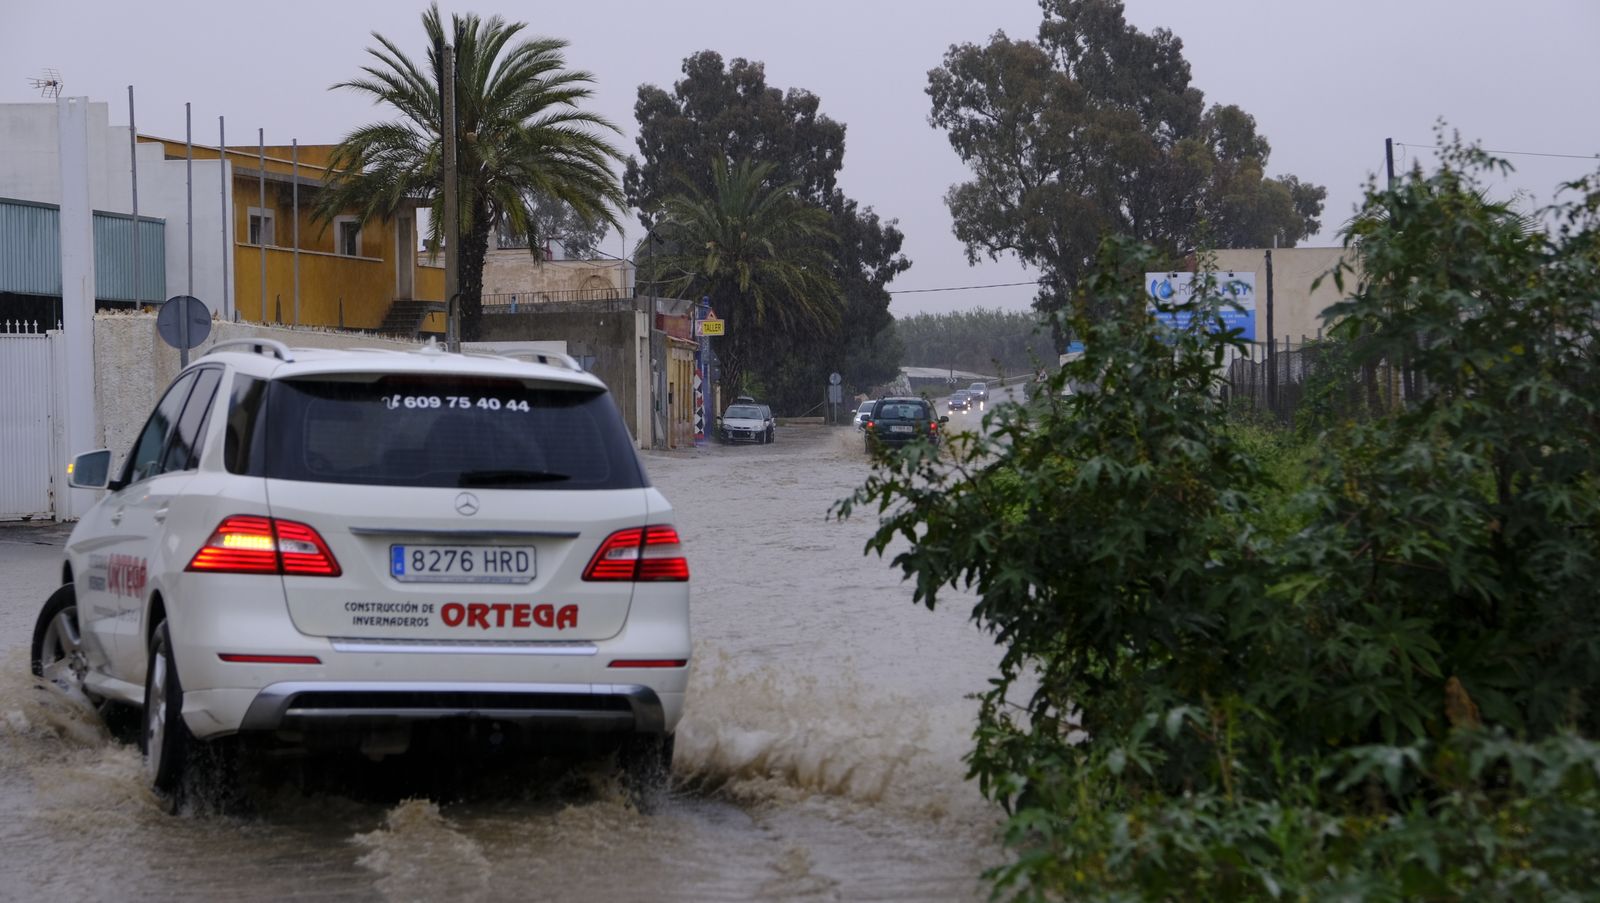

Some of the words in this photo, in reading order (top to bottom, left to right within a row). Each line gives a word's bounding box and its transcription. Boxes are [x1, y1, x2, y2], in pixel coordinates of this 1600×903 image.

[704, 323, 721, 332] TALLER
[404, 396, 441, 409] 609
[446, 396, 472, 409] 75
[477, 397, 501, 410] 40
[506, 399, 530, 412] 44
[412, 550, 473, 572] 8276
[484, 550, 529, 573] HRD
[344, 601, 418, 613] CONSTRUCCIÓN
[421, 602, 435, 614] DE
[352, 616, 430, 628] INVERNADEROS
[440, 602, 579, 630] ORTEGA
